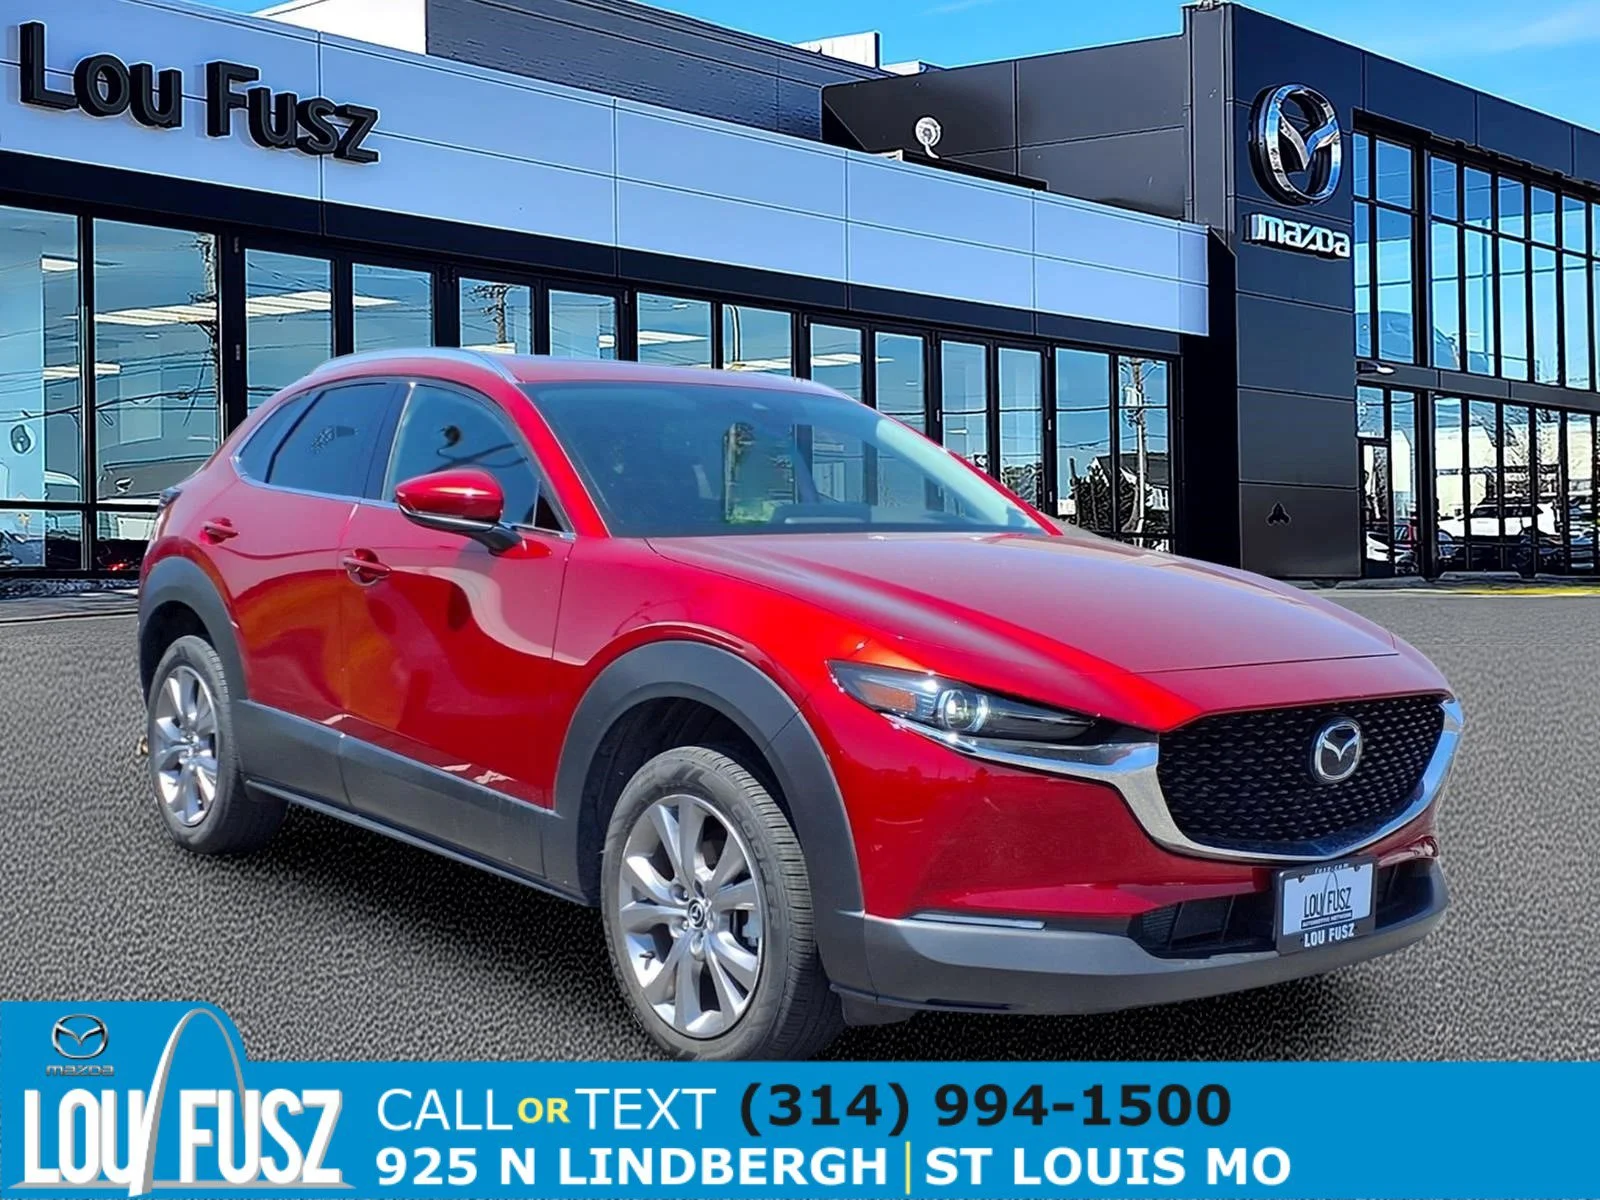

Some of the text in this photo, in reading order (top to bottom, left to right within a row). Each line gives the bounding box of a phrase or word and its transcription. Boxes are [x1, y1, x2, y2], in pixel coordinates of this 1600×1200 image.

[19, 22, 379, 163] Lou Fusz
[1304, 887, 1351, 918] LOU FUSZ
[1304, 923, 1354, 947] LOU FUSZ
